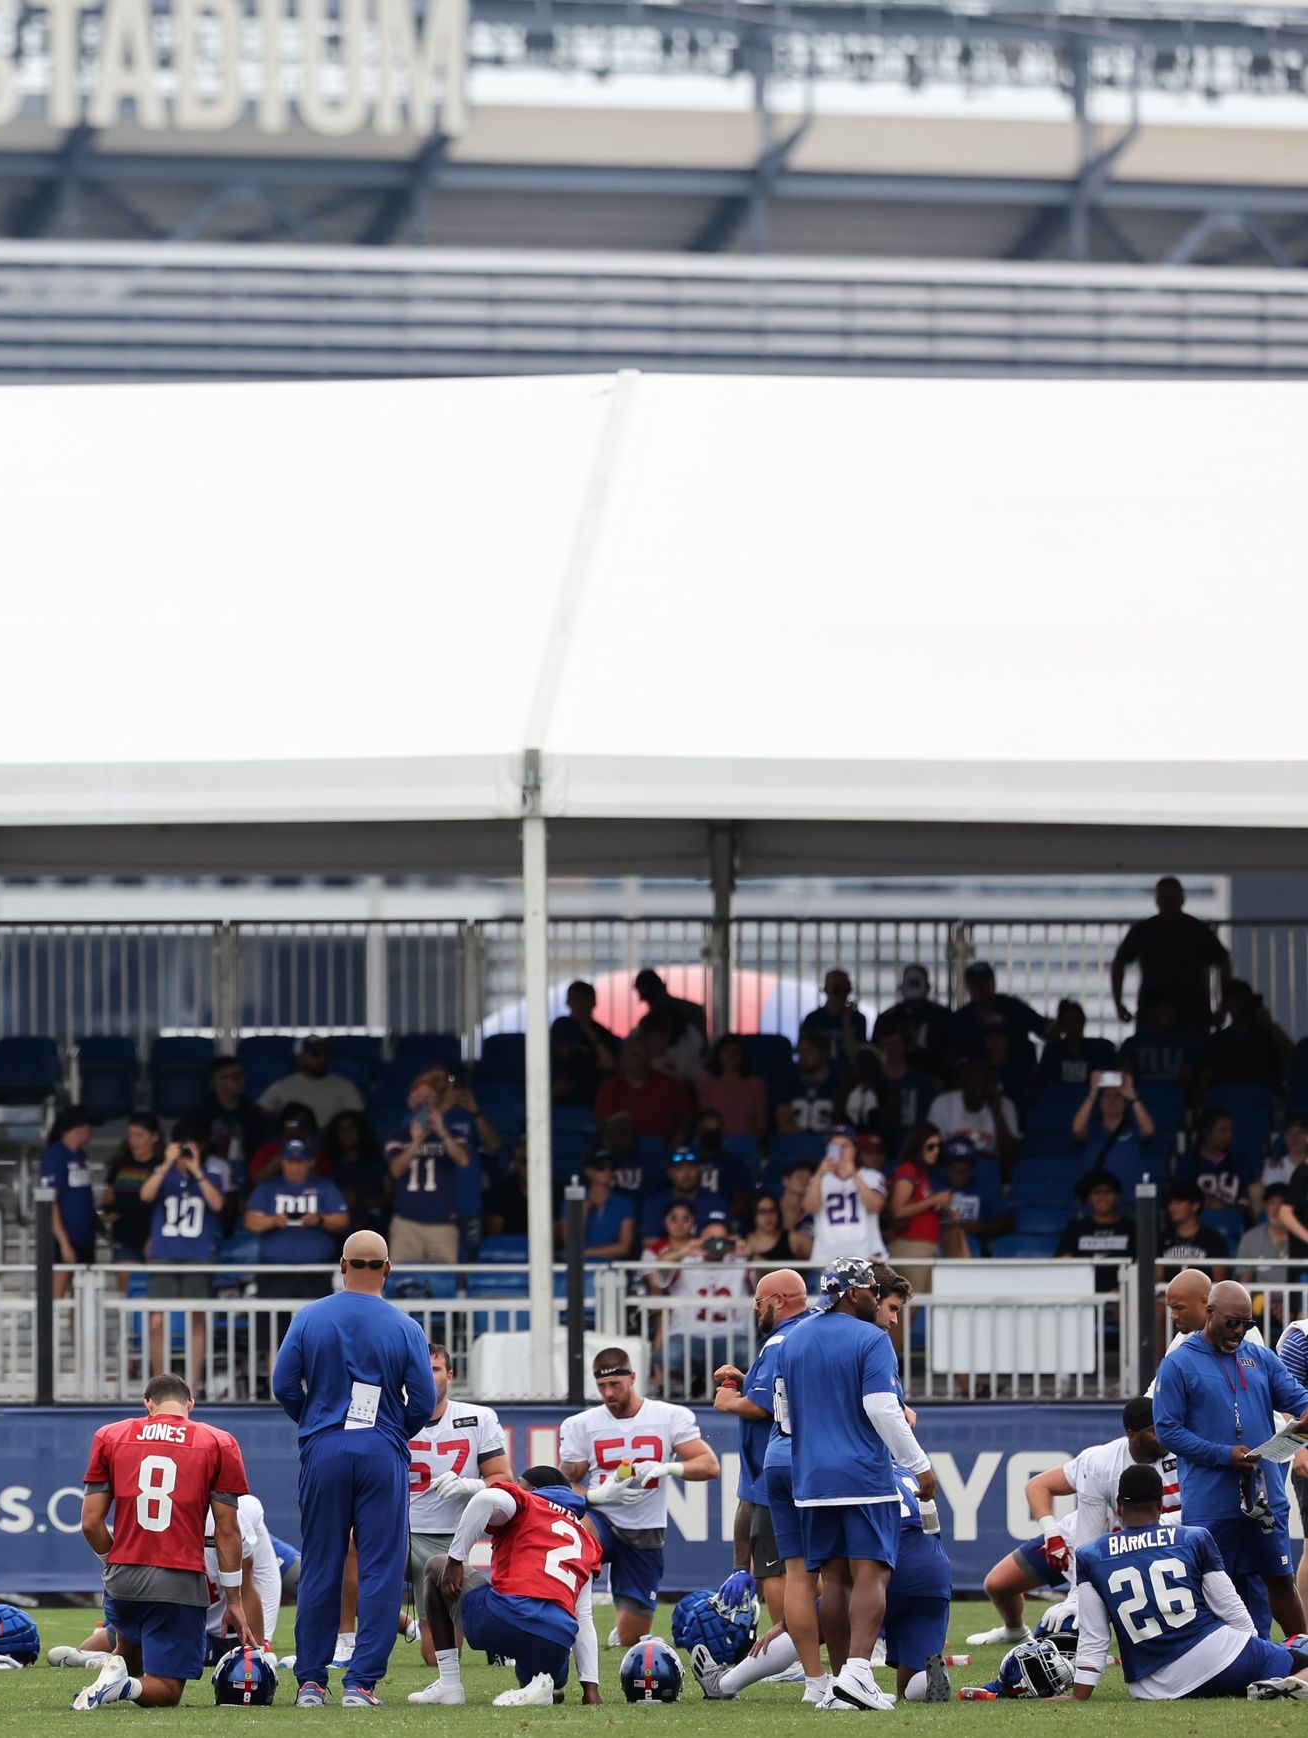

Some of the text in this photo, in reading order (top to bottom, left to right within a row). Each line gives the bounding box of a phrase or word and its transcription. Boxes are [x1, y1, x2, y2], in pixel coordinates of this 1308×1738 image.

[407, 1158, 437, 1192] 11
[161, 1196, 205, 1238] 10
[827, 1192, 859, 1225] 21
[136, 1423, 187, 1444] JONES
[136, 1455, 178, 1533] 8
[544, 1518, 584, 1593] 2
[1109, 1528, 1177, 1556] BARKLEY
[1107, 1557, 1198, 1645] 26
[243, 1692, 251, 1703] 8
